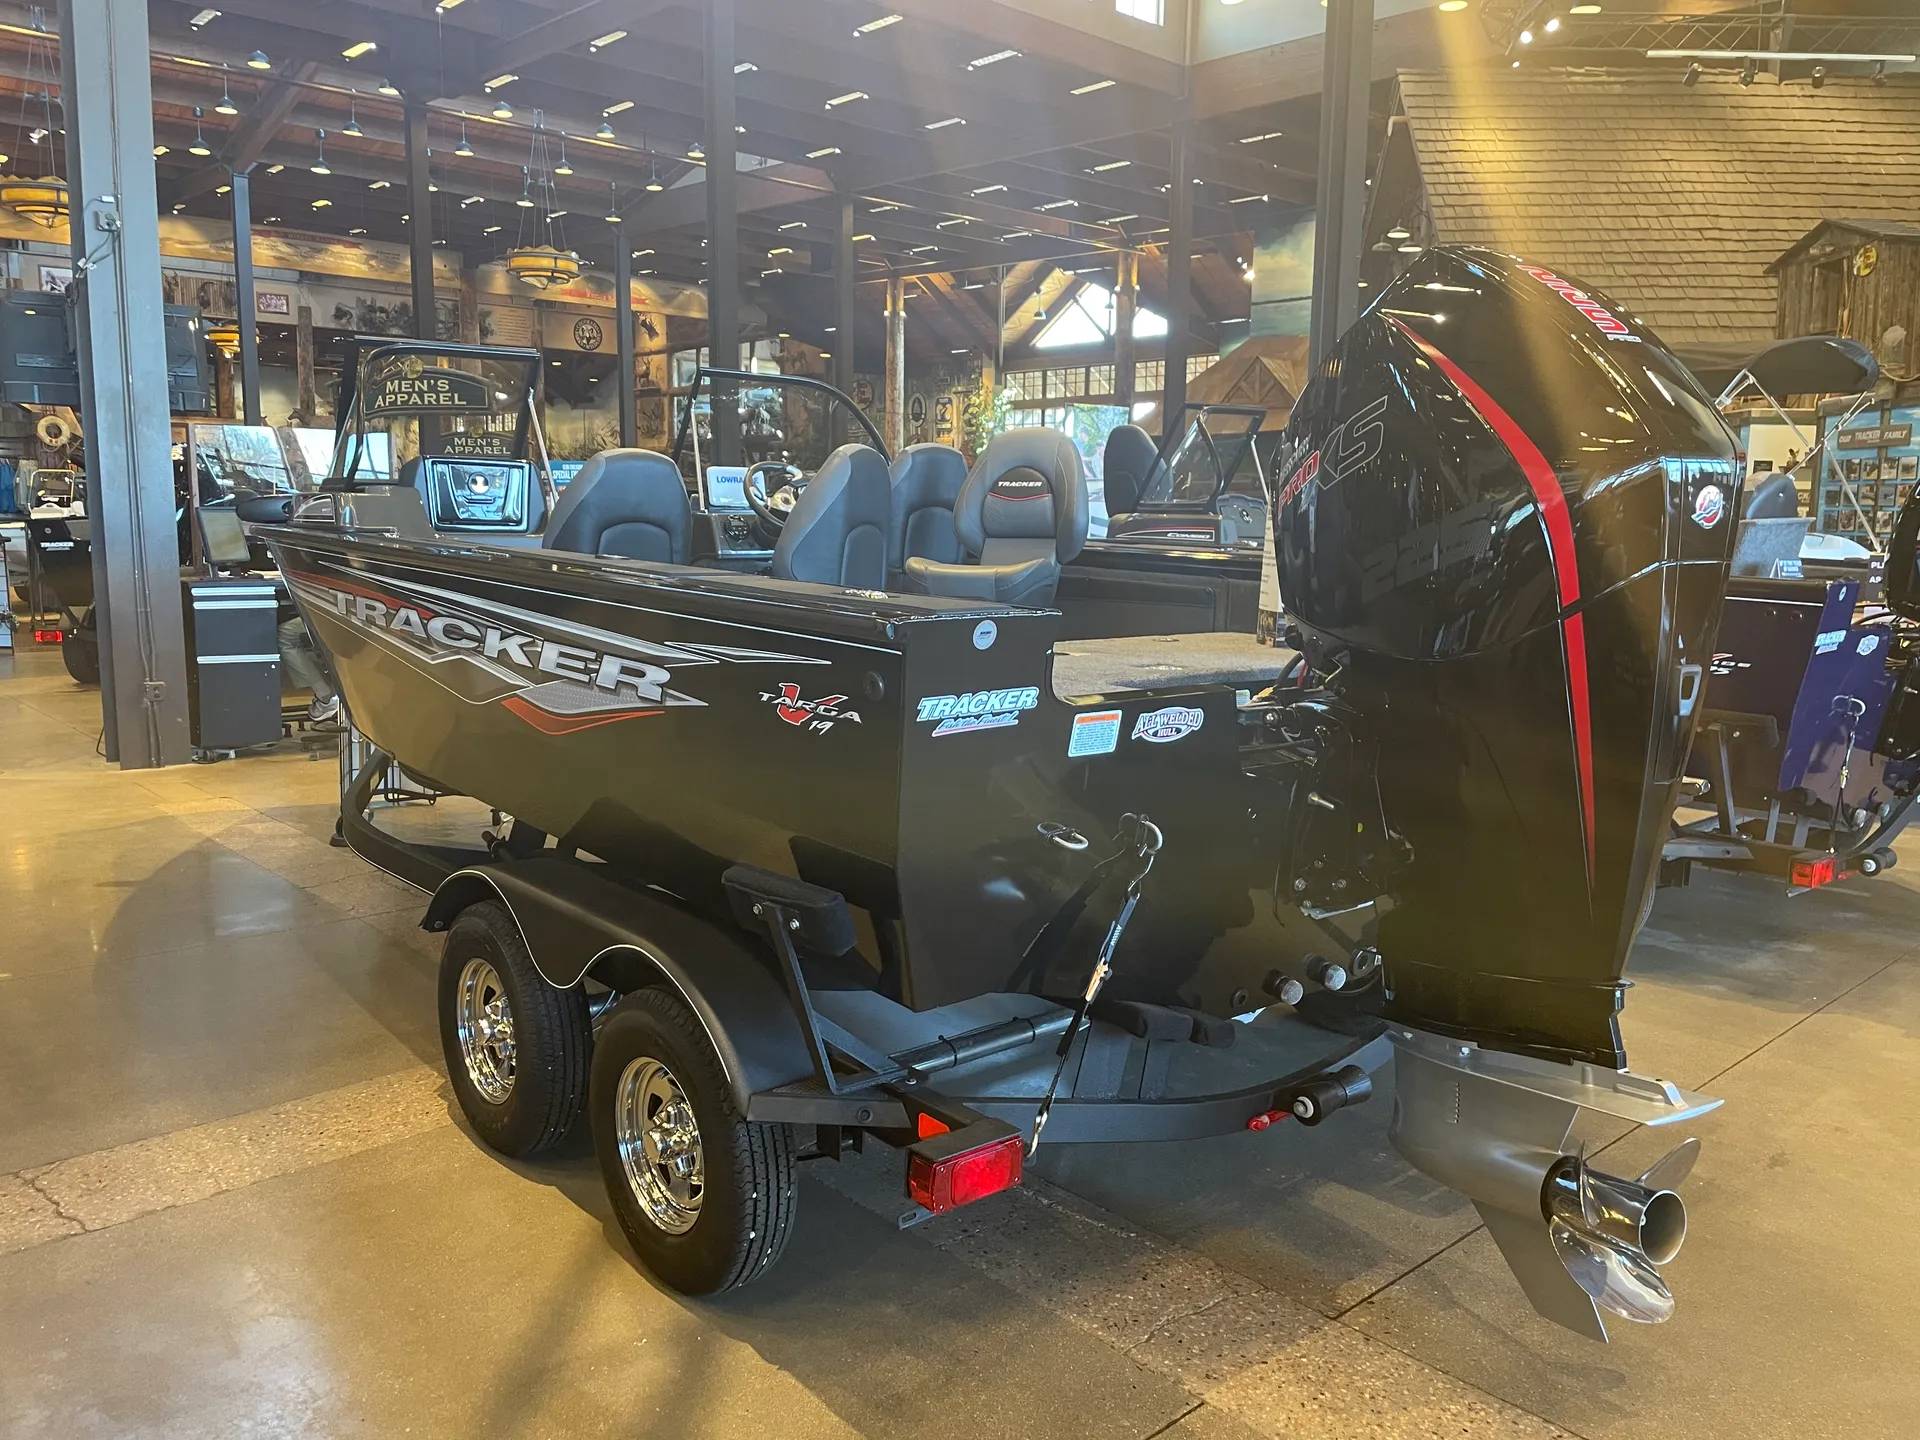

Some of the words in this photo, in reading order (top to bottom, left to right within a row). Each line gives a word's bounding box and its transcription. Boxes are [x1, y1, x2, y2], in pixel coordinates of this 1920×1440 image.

[386, 379, 449, 394] MEN'S
[374, 393, 467, 409] APPAREL
[454, 437, 500, 446] MEN'S
[1855, 430, 1880, 440] TRACKER
[1883, 430, 1908, 440] FAMILY
[444, 446, 511, 455] APPAREL
[716, 476, 760, 484] LOWRAE
[1277, 450, 1320, 521] PRO
[328, 588, 671, 702] TRACKER
[759, 692, 863, 725] TARGA
[919, 689, 1037, 720] TRACKER
[808, 720, 835, 735] 19
[1136, 714, 1158, 734] ALL
[1159, 710, 1203, 728] WELDED
[1157, 726, 1178, 737] HULL
